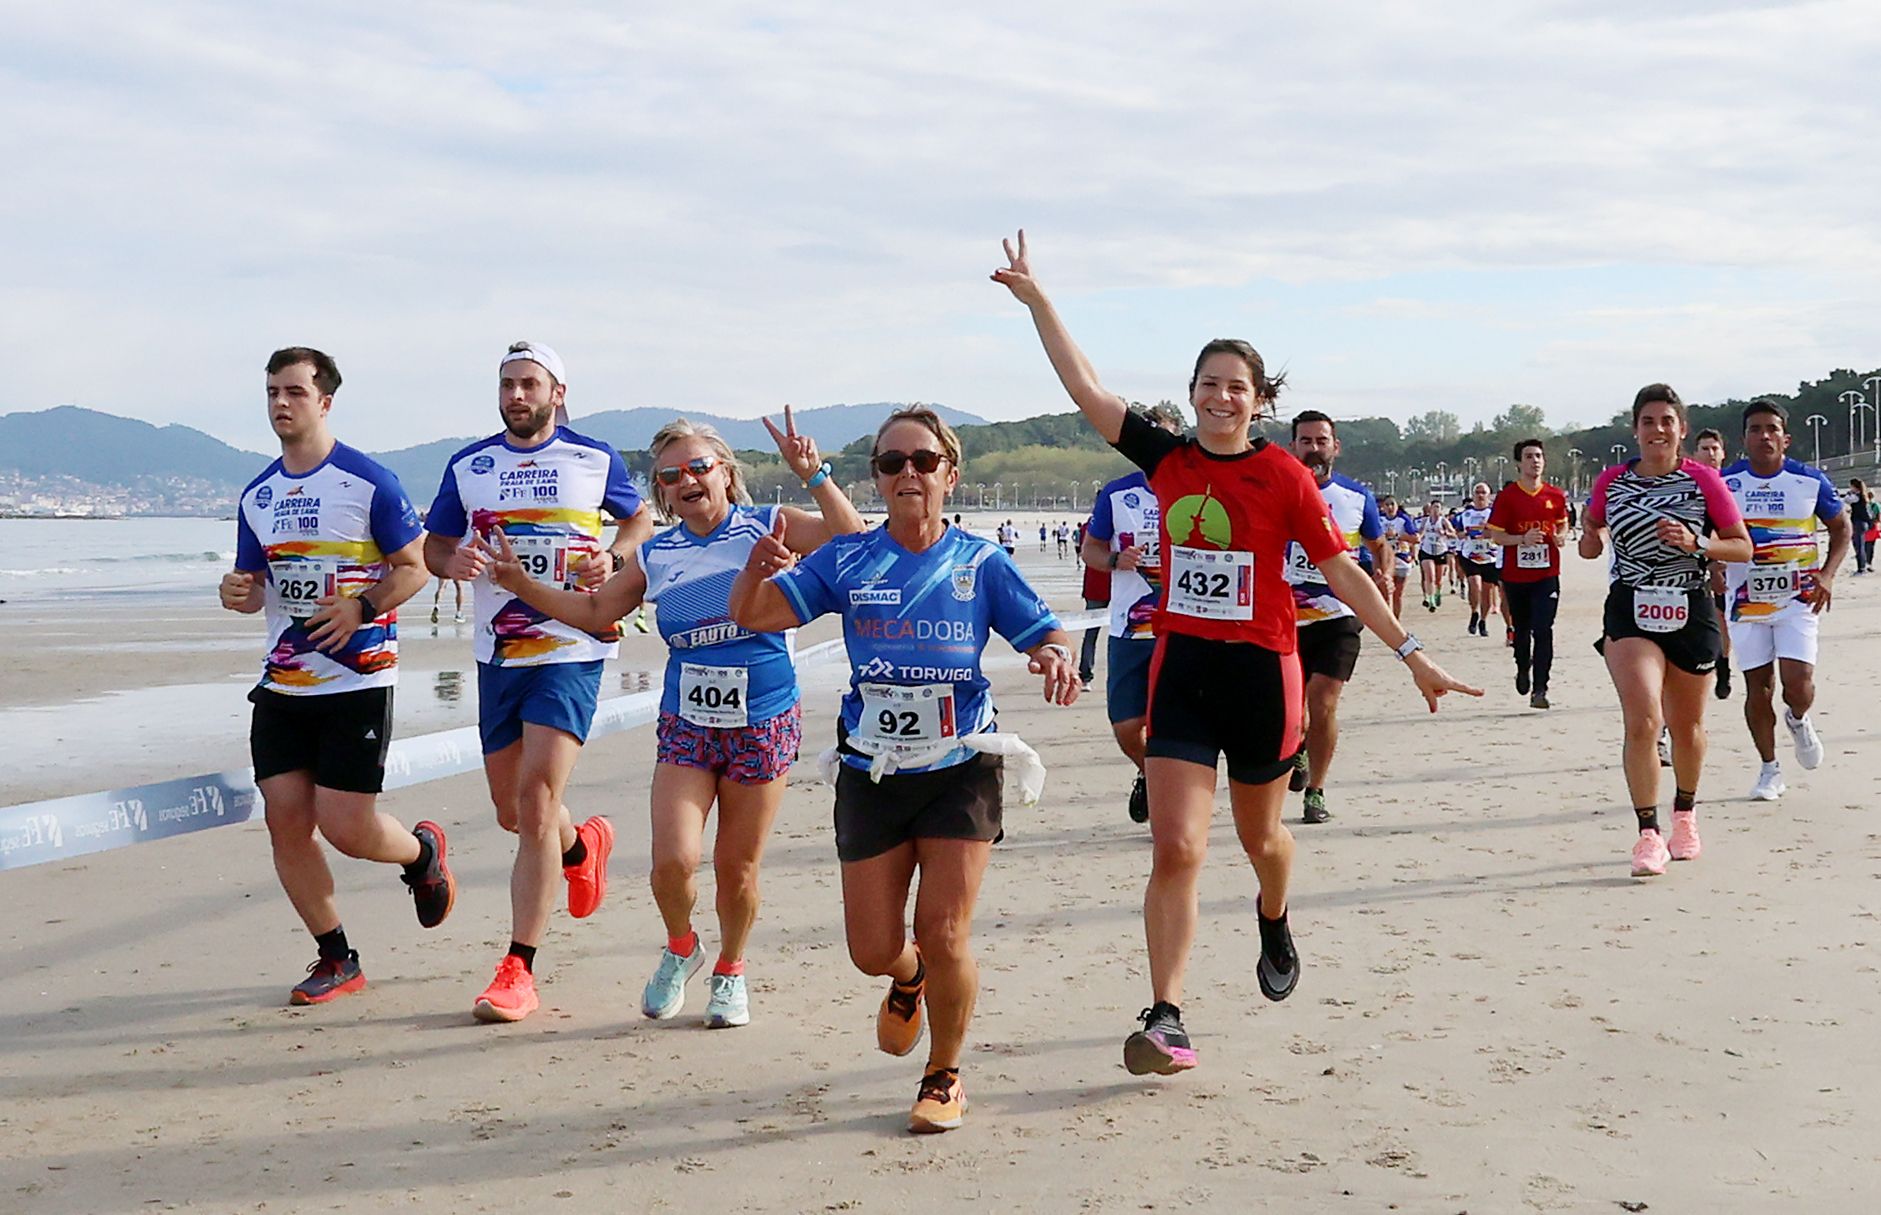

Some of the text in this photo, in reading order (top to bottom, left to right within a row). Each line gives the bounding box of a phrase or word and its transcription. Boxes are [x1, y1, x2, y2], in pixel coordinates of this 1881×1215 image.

[499, 469, 559, 480] CARREIRA
[532, 486, 558, 497] 100
[274, 497, 321, 512] CARREIRA
[297, 516, 319, 529] 100
[279, 578, 319, 600] 262
[1177, 569, 1230, 598] 432
[1753, 576, 1788, 591] 370
[851, 591, 899, 603] DISMAC
[1637, 604, 1687, 620] 2006
[854, 617, 976, 642] MECADOBA
[898, 665, 973, 681] TORVIGO
[688, 685, 741, 709] 404
[878, 709, 921, 736] 92
